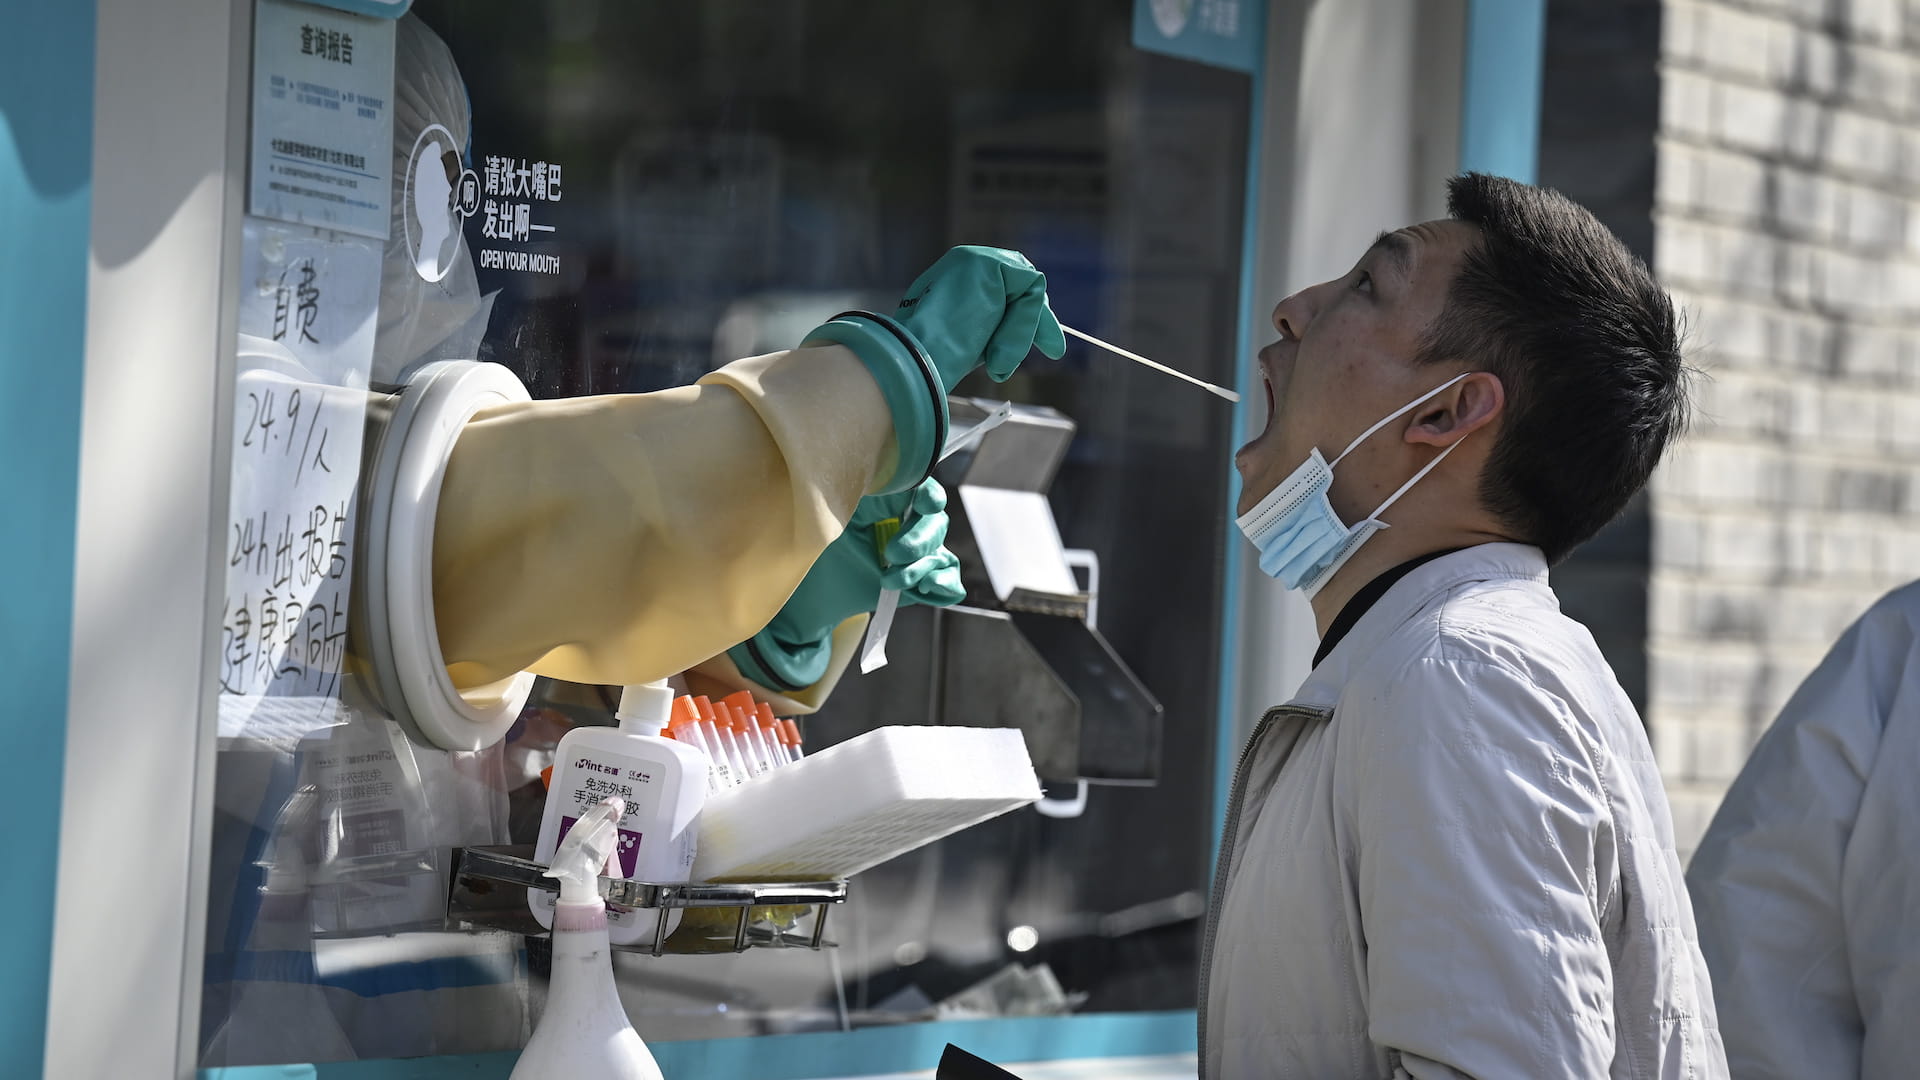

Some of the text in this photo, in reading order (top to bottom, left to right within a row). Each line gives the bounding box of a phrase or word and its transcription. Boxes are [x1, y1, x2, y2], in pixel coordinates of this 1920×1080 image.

[301, 23, 353, 66] 查询报告
[484, 155, 562, 202] 请张大嘴巴
[462, 180, 475, 209] 啊
[480, 249, 561, 274] OPEN YOUR MOUTH
[272, 257, 320, 345] 自费
[584, 777, 633, 799] 免洗外科
[573, 789, 640, 817] 手消胶
